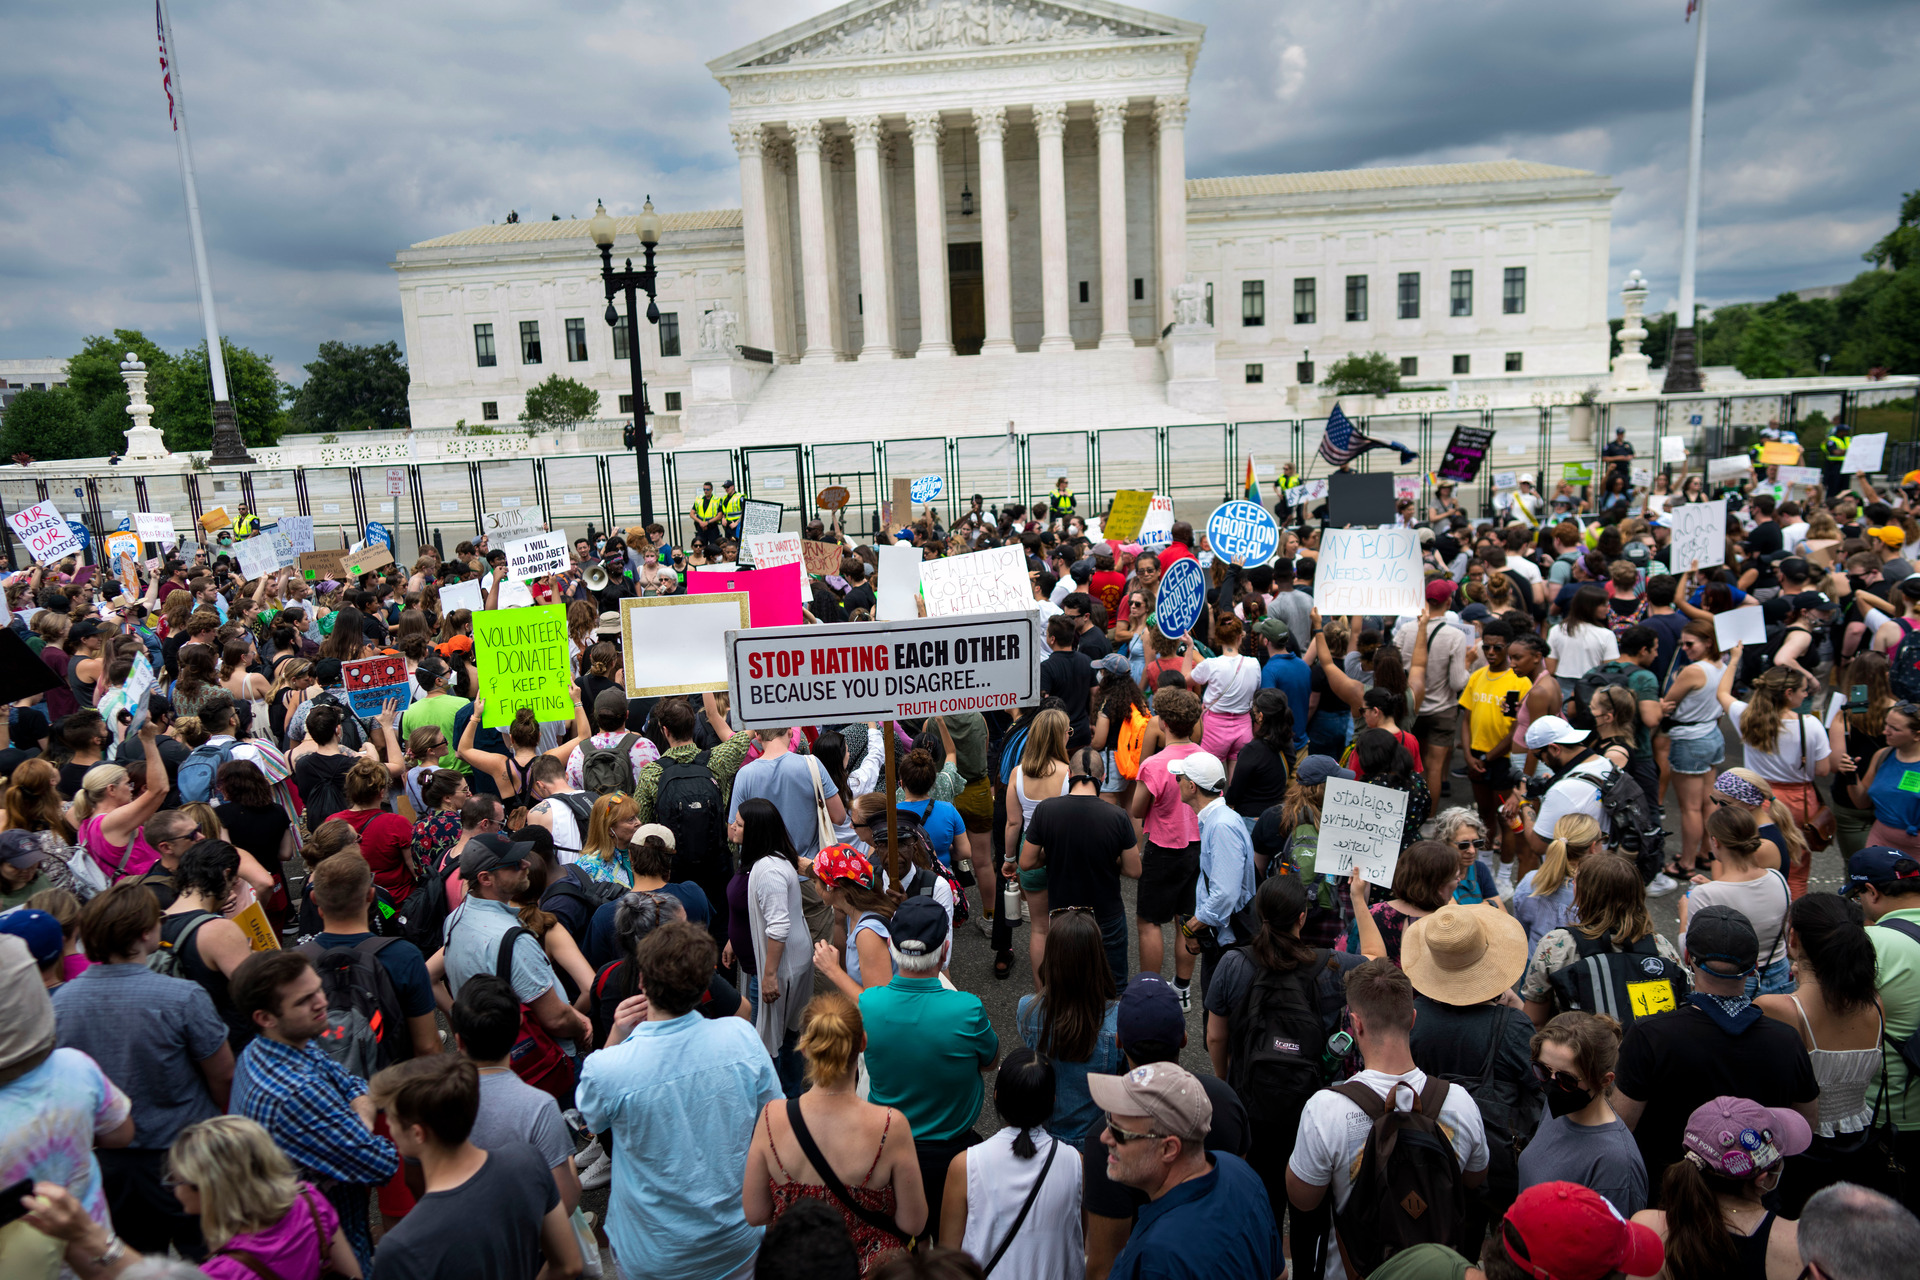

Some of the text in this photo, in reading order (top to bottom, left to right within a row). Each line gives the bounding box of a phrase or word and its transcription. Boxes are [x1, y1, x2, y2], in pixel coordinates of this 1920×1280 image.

[917, 475, 938, 484] KEEP
[912, 489, 937, 499] LEGAL
[14, 506, 50, 528] OUR
[1225, 504, 1267, 524] KEEP
[1674, 504, 1718, 542] 2022
[19, 516, 60, 540] BODIES
[32, 528, 66, 551] OUR
[369, 526, 388, 537] ABORTION
[1212, 515, 1274, 546] ABORTION
[512, 546, 565, 566] AID AND ABET
[524, 540, 549, 552] I WILL
[754, 539, 800, 555] IF I WANTED
[1215, 534, 1267, 560] LEGAL
[1321, 533, 1416, 560] MY BODY
[517, 558, 564, 576] ABORTION
[922, 549, 1021, 581] WE WILL NOT
[1324, 561, 1408, 582] NEEDS NO
[930, 573, 1007, 600] GO BACK
[1162, 561, 1189, 598] KEEP
[928, 584, 1022, 617] WE WILL BURN
[1158, 568, 1202, 623] ABORTION
[1320, 581, 1423, 609] REGULATION
[1166, 592, 1201, 631] LEGAL
[480, 620, 568, 648] VOLUNTEER,
[496, 645, 564, 674] DONATE!
[749, 634, 1020, 680] STOP HATING EACH OTHER
[512, 677, 547, 692] KEEP
[751, 669, 992, 705] BECAUSE YOU DISAGREE...
[500, 696, 564, 715] FIGHTING
[897, 692, 1017, 717] TRUTH CONDUCTOR
[1473, 692, 1503, 705] OBEY
[1723, 1153, 1744, 1164] NASTY
[1729, 1163, 1752, 1175] UNITE
